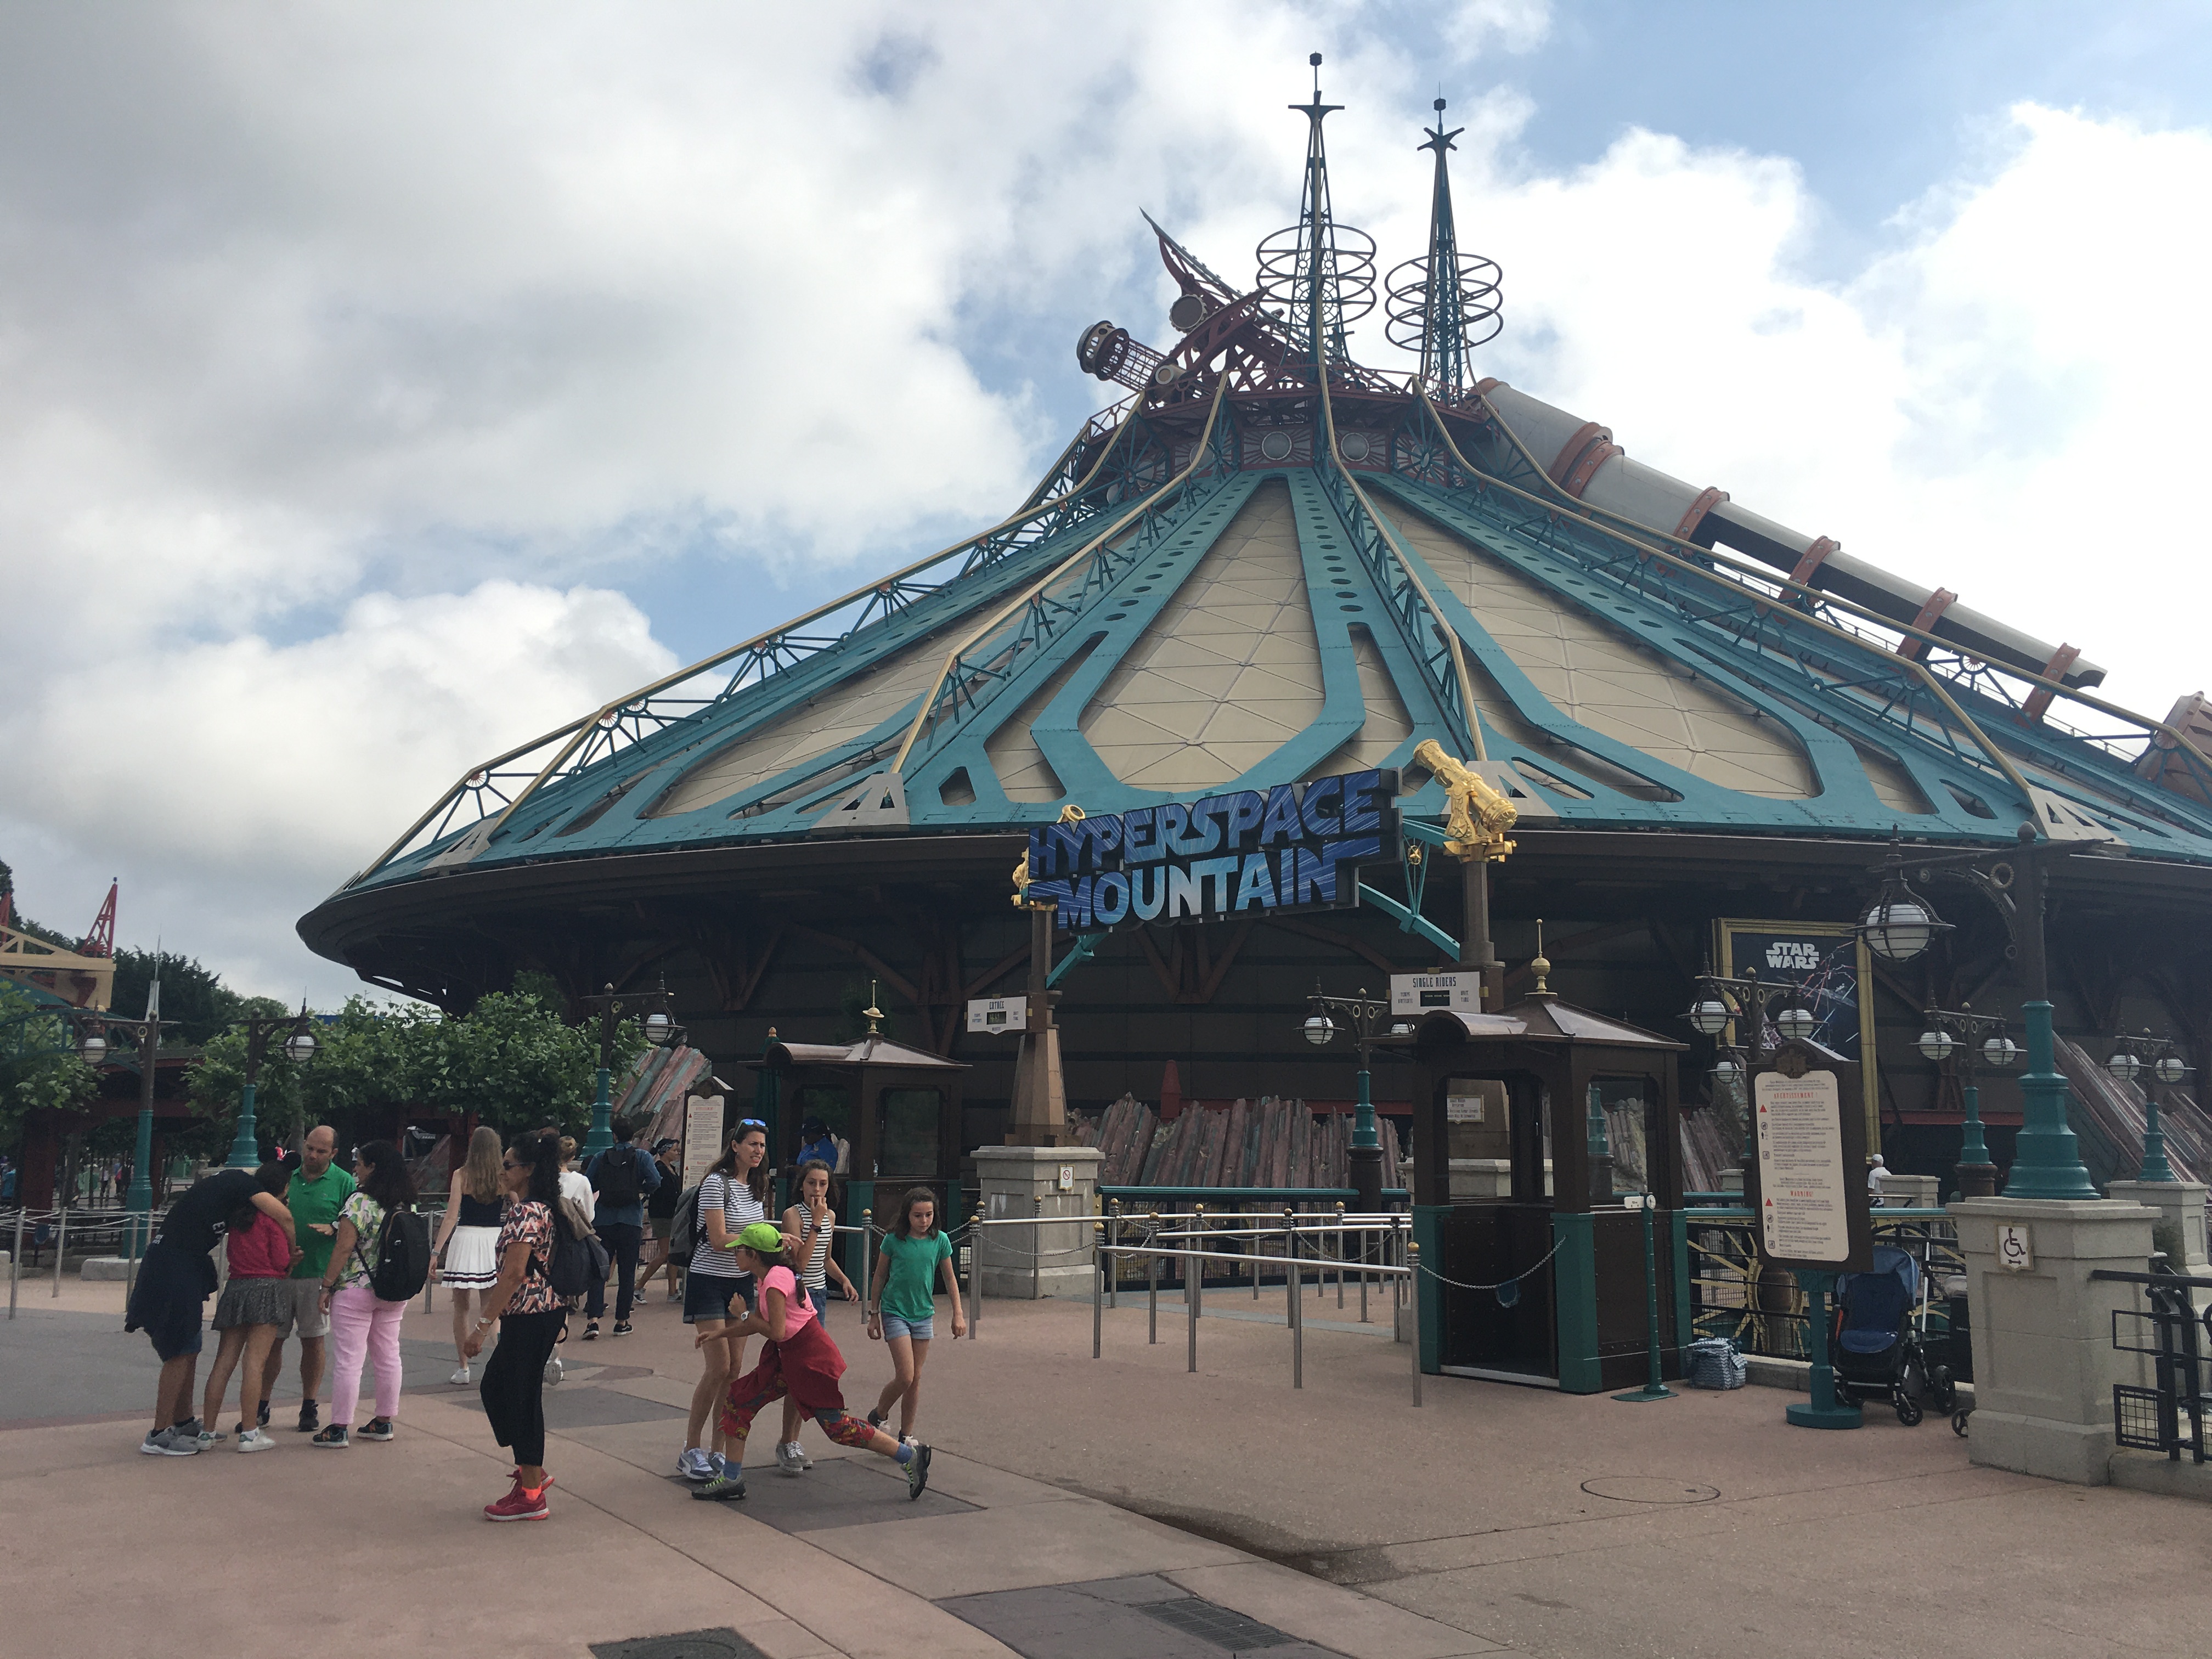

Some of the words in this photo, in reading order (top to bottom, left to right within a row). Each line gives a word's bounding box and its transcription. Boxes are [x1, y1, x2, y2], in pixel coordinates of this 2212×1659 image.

[1029, 769, 1381, 878] HYPERSPACE
[1029, 836, 1381, 929] MOUNTAIN
[1765, 942, 1819, 956] STAR
[1766, 955, 1820, 969] WARS
[1413, 977, 1433, 988] SINGLE
[1435, 977, 1457, 987] RIDERS
